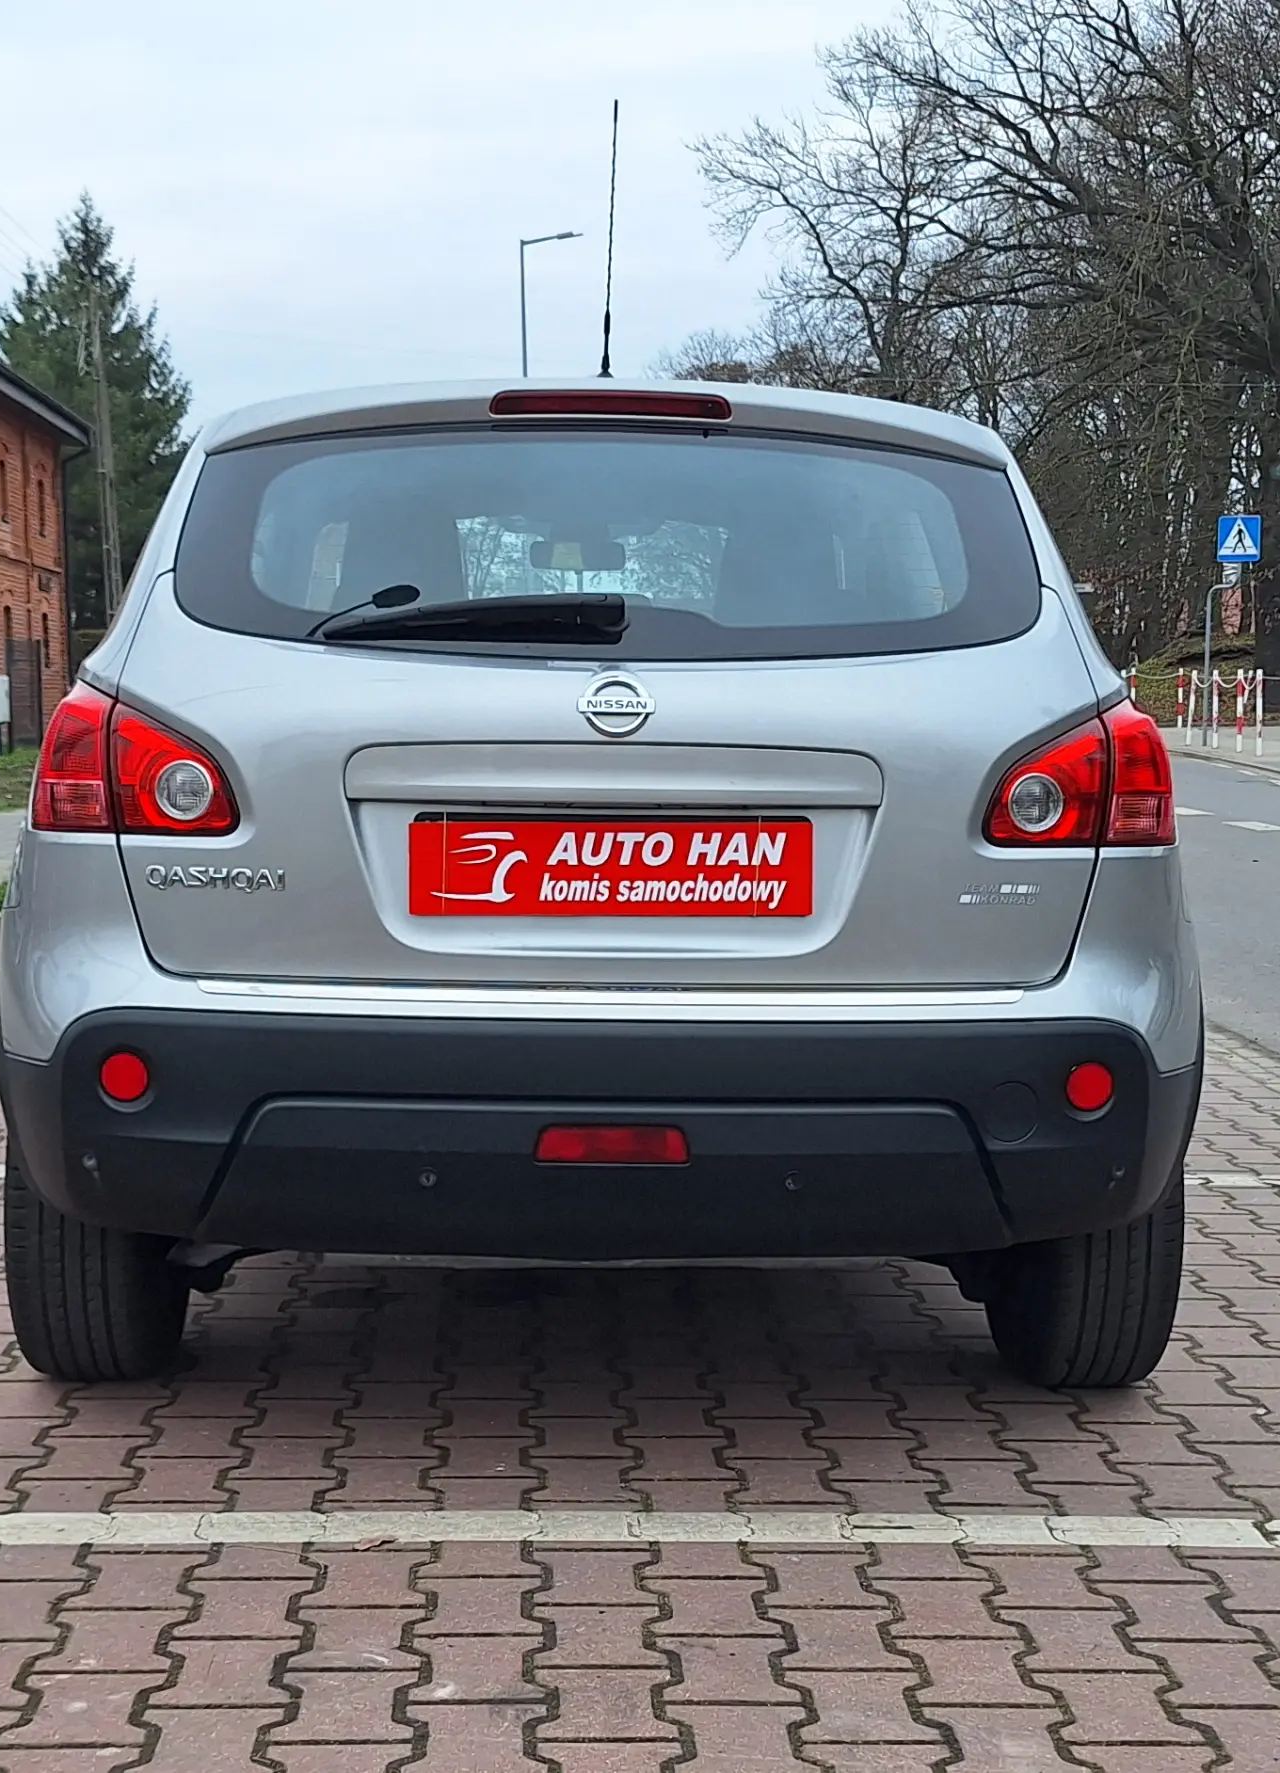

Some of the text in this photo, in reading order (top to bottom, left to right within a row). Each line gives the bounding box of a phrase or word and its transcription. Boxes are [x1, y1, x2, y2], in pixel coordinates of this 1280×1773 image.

[586, 699, 648, 710] NISSAN
[546, 832, 787, 867] AUTO HAN
[145, 864, 285, 893] QASHQAI
[539, 872, 787, 909] komis samochodowy
[980, 894, 1036, 906] KONRAD
